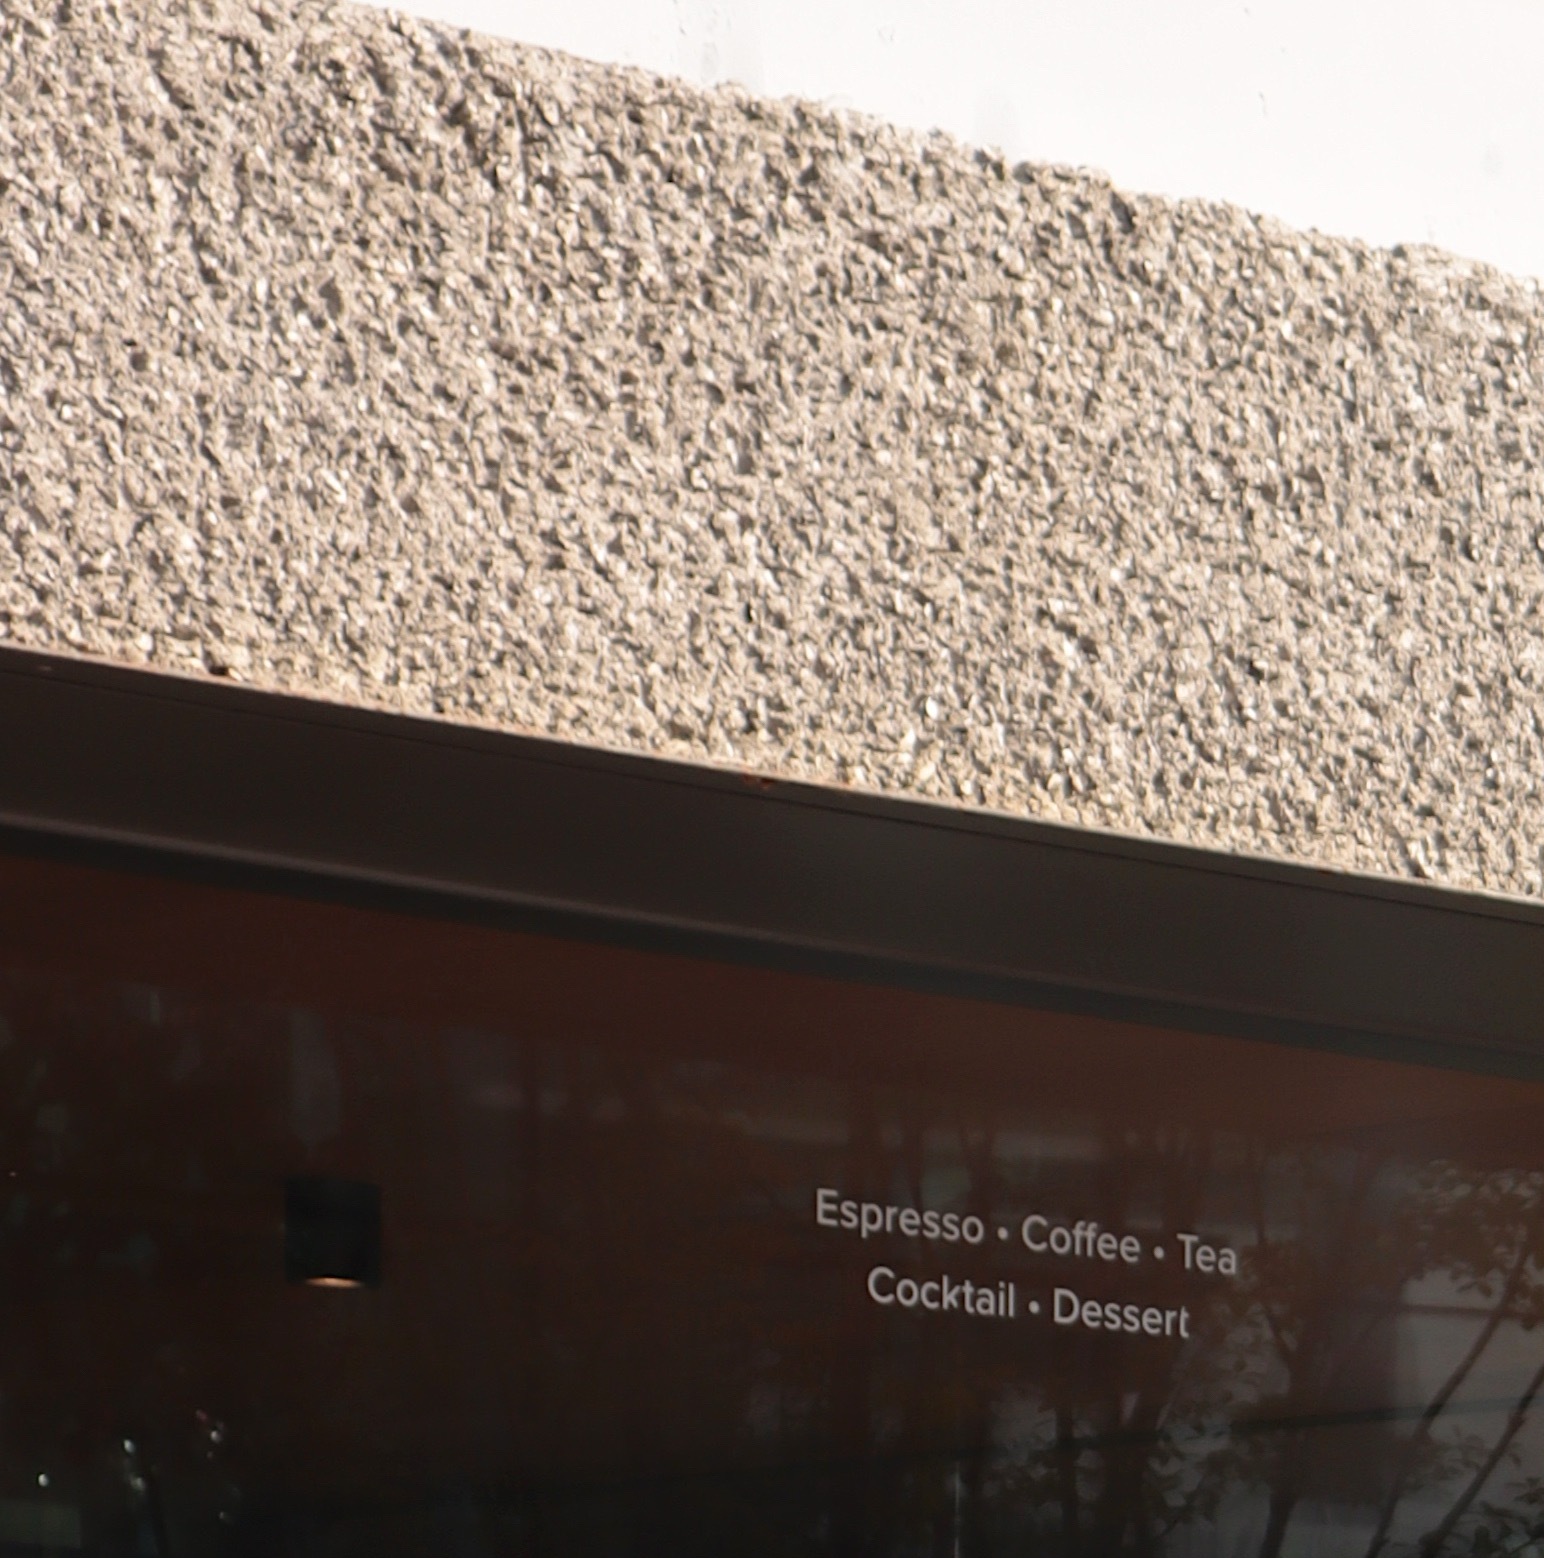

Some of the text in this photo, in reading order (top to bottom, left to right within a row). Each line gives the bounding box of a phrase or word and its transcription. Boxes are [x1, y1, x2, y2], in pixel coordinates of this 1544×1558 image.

[815, 1187, 1238, 1276] Espresso Coffee Tea
[866, 1265, 1190, 1340] Cocktail Dessert
